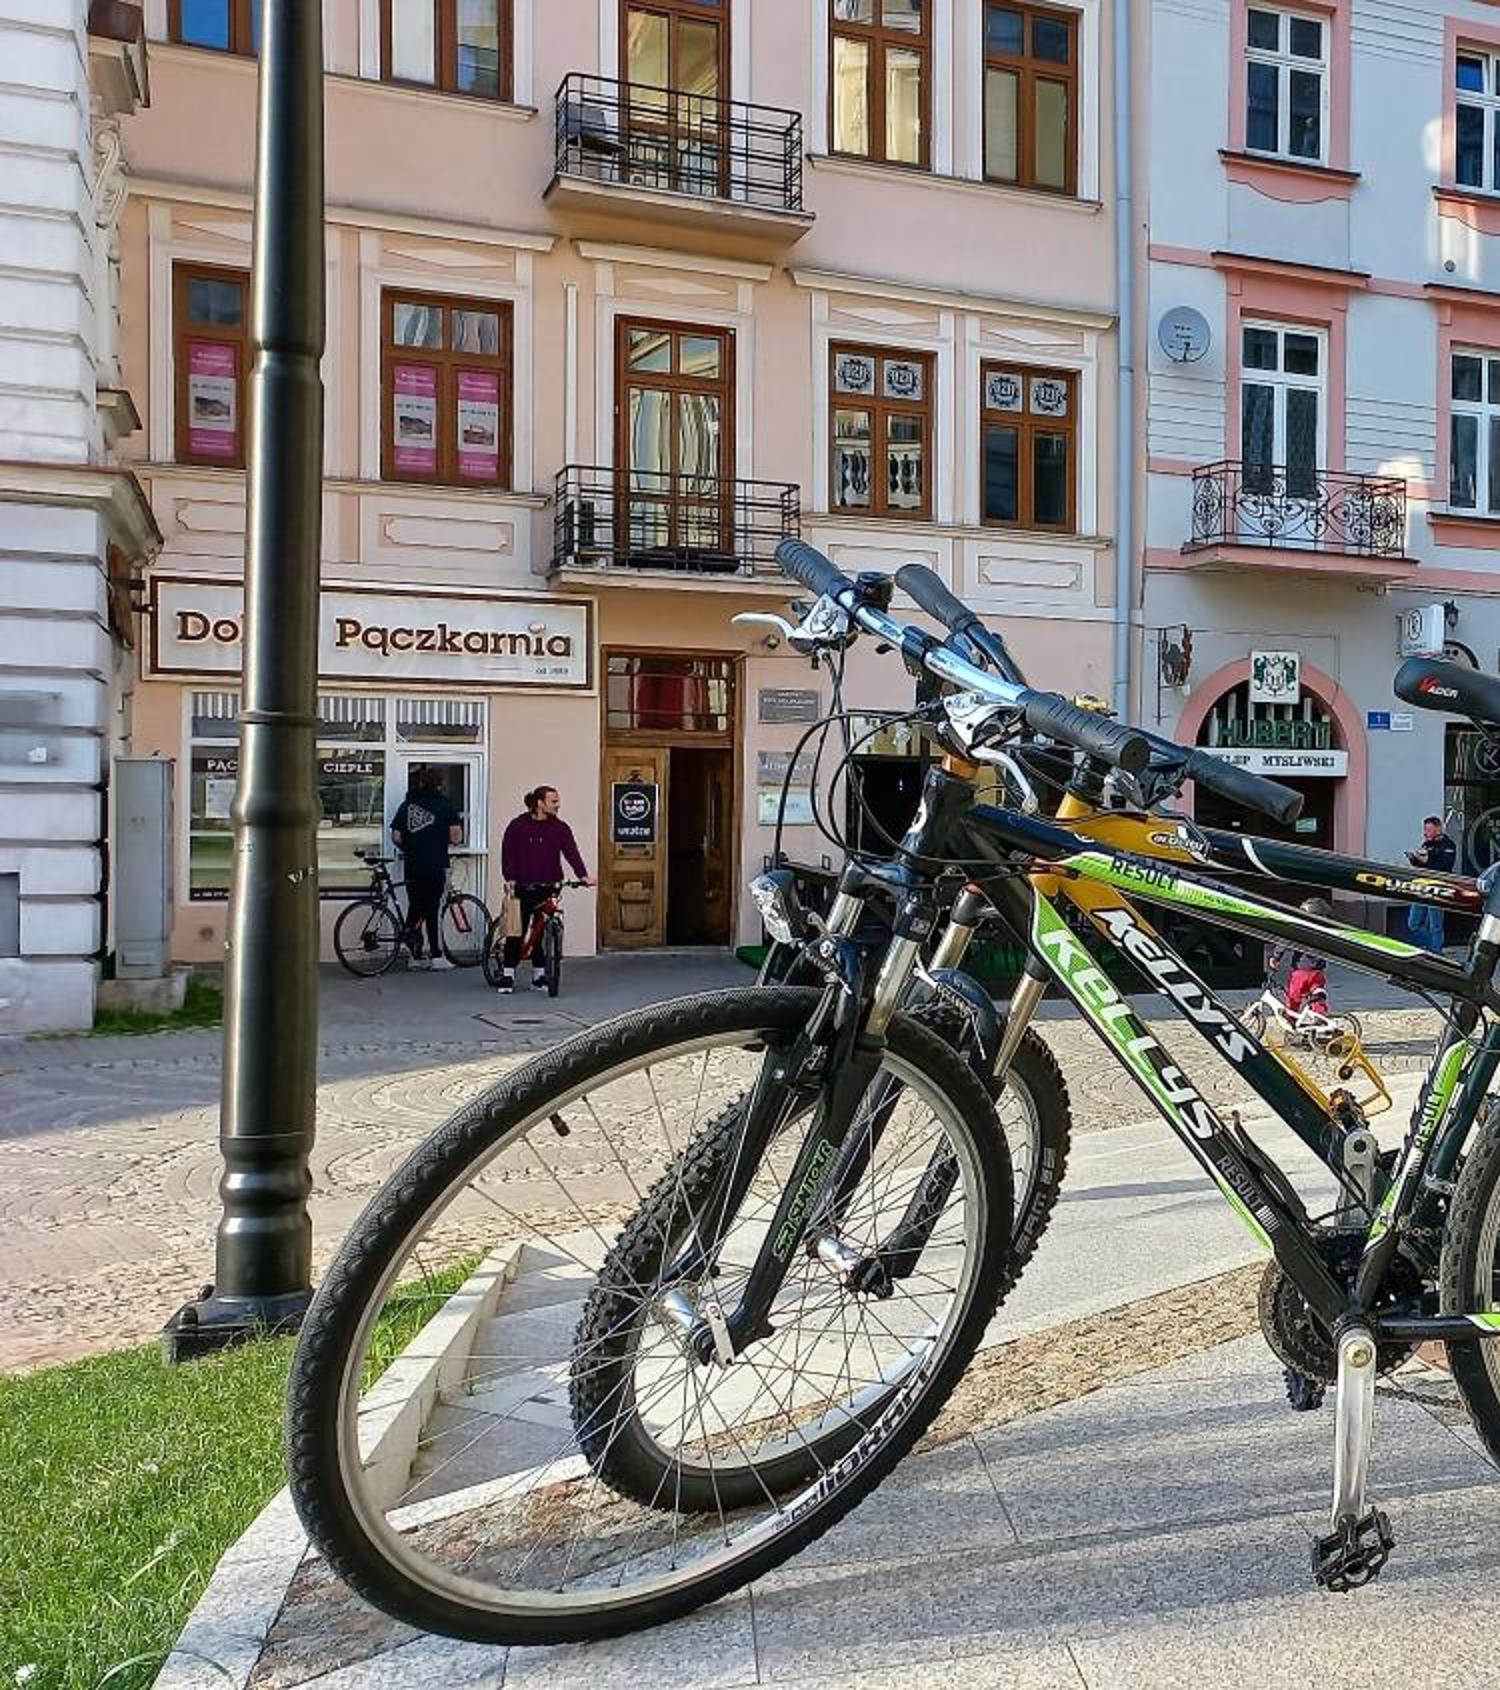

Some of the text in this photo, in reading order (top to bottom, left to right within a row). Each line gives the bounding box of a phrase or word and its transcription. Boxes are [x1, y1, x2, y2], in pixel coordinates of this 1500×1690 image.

[177, 611, 571, 657] Do Pączkarnia
[1217, 719, 1331, 749] HUBERT
[1109, 853, 1179, 892] RESULT
[1414, 1091, 1444, 1151] RESULT
[1216, 1155, 1264, 1208] RESULT
